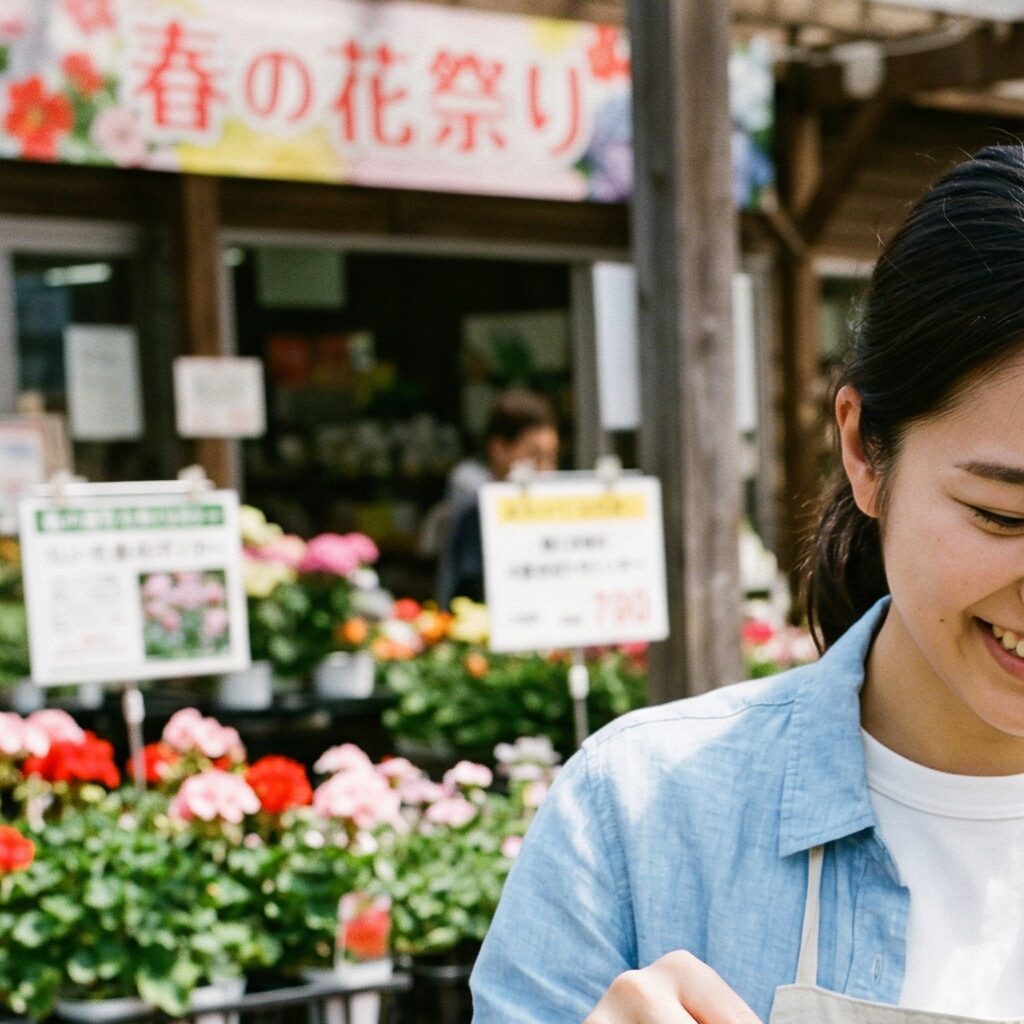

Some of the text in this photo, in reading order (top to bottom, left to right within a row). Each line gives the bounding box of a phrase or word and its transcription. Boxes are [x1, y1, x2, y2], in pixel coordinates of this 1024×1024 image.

[131, 20, 584, 156] 春の花祭り
